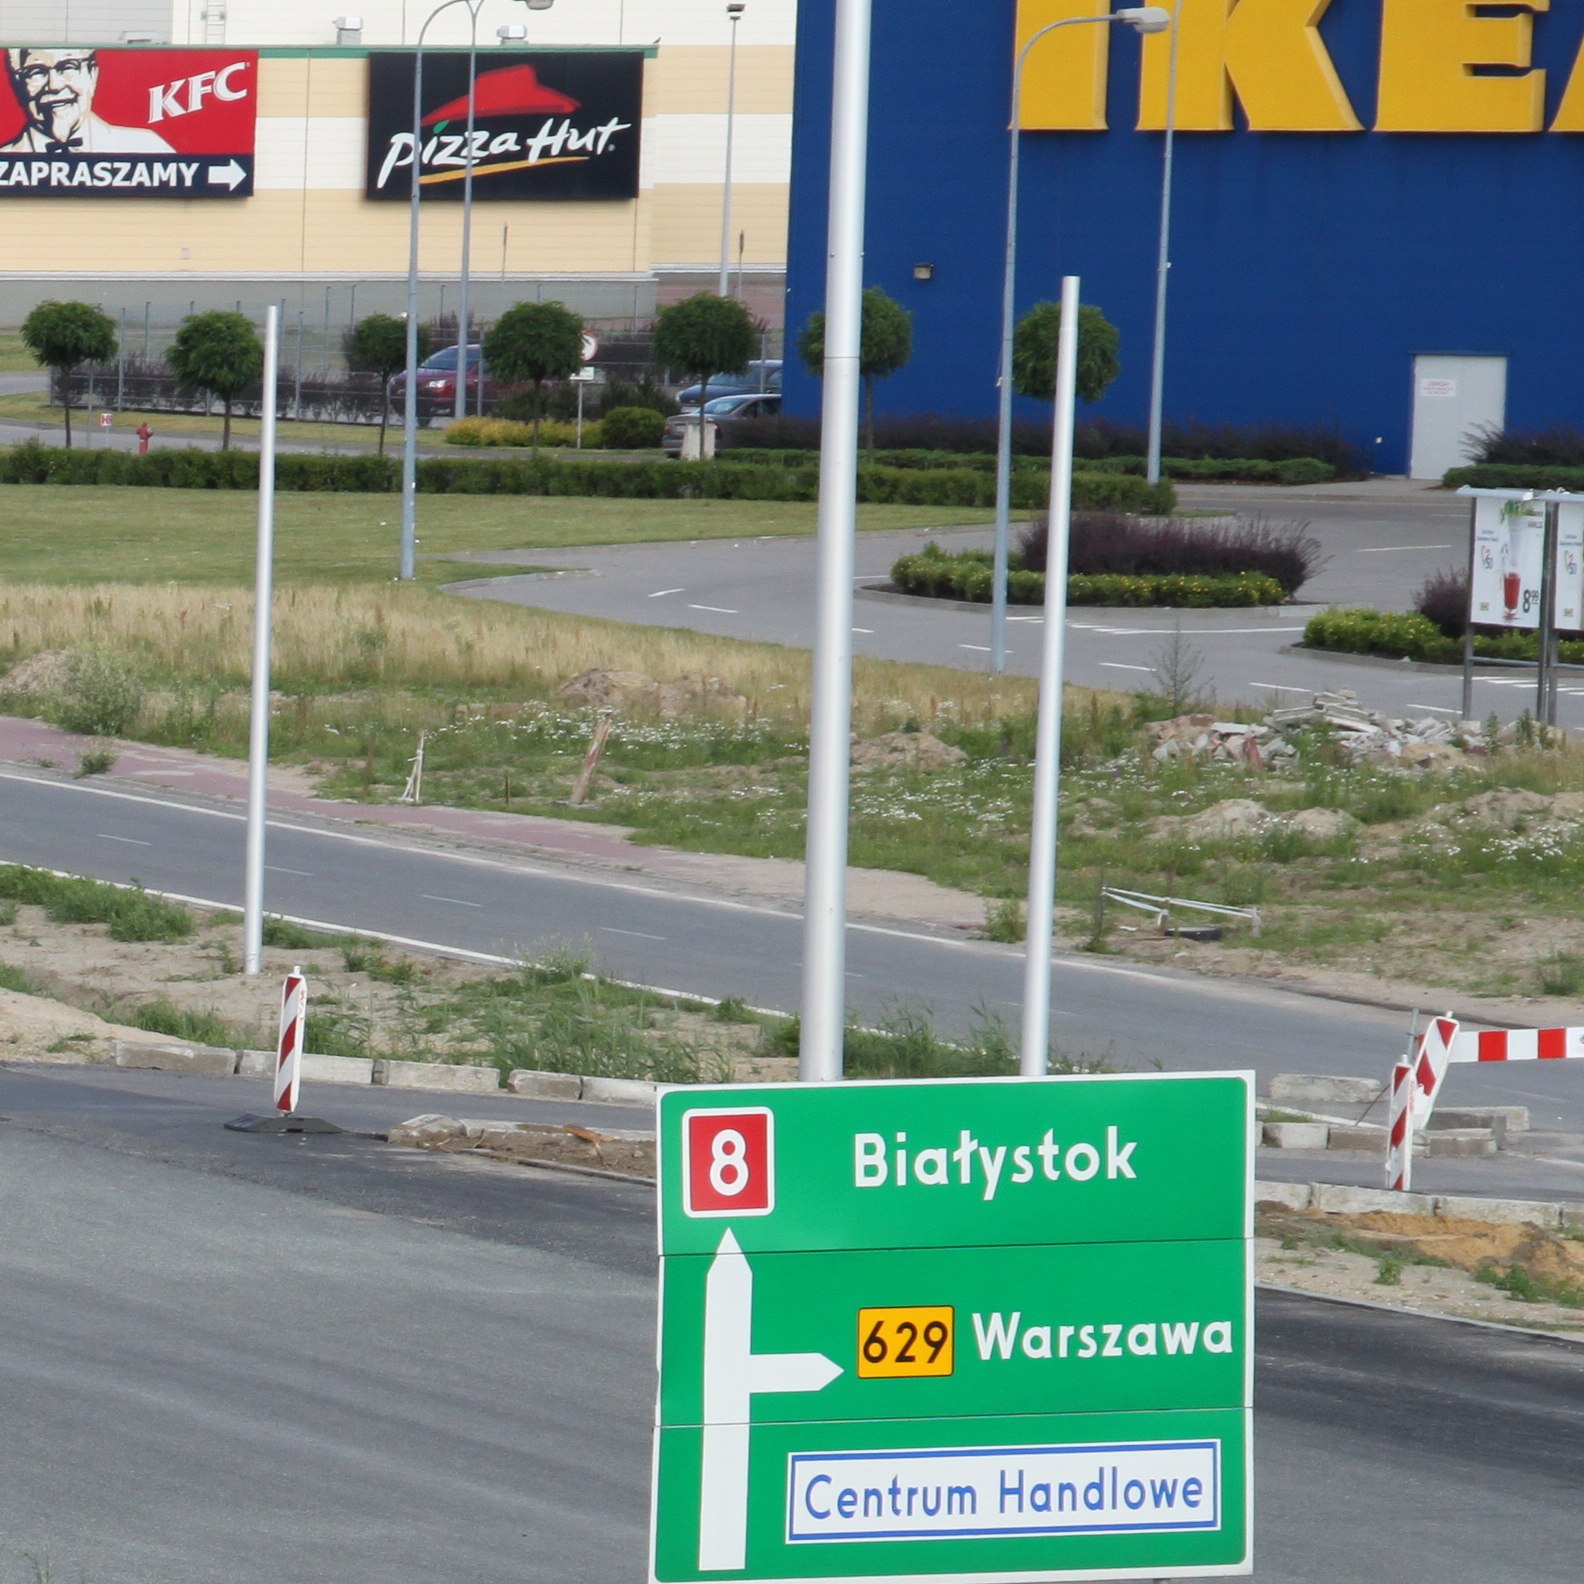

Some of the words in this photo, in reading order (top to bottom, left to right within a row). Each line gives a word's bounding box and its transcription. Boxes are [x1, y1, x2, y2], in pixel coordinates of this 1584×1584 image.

[148, 62, 248, 124] KFC
[1007, 0, 1584, 132] IKE
[526, 117, 632, 164] Hut
[709, 1128, 749, 1197] 8
[853, 1125, 1138, 1201] Białystok
[862, 1320, 949, 1364] 629
[972, 1311, 1234, 1361] Warszawa
[804, 1472, 978, 1519] Centrum
[999, 1466, 1204, 1515] Handlowe
